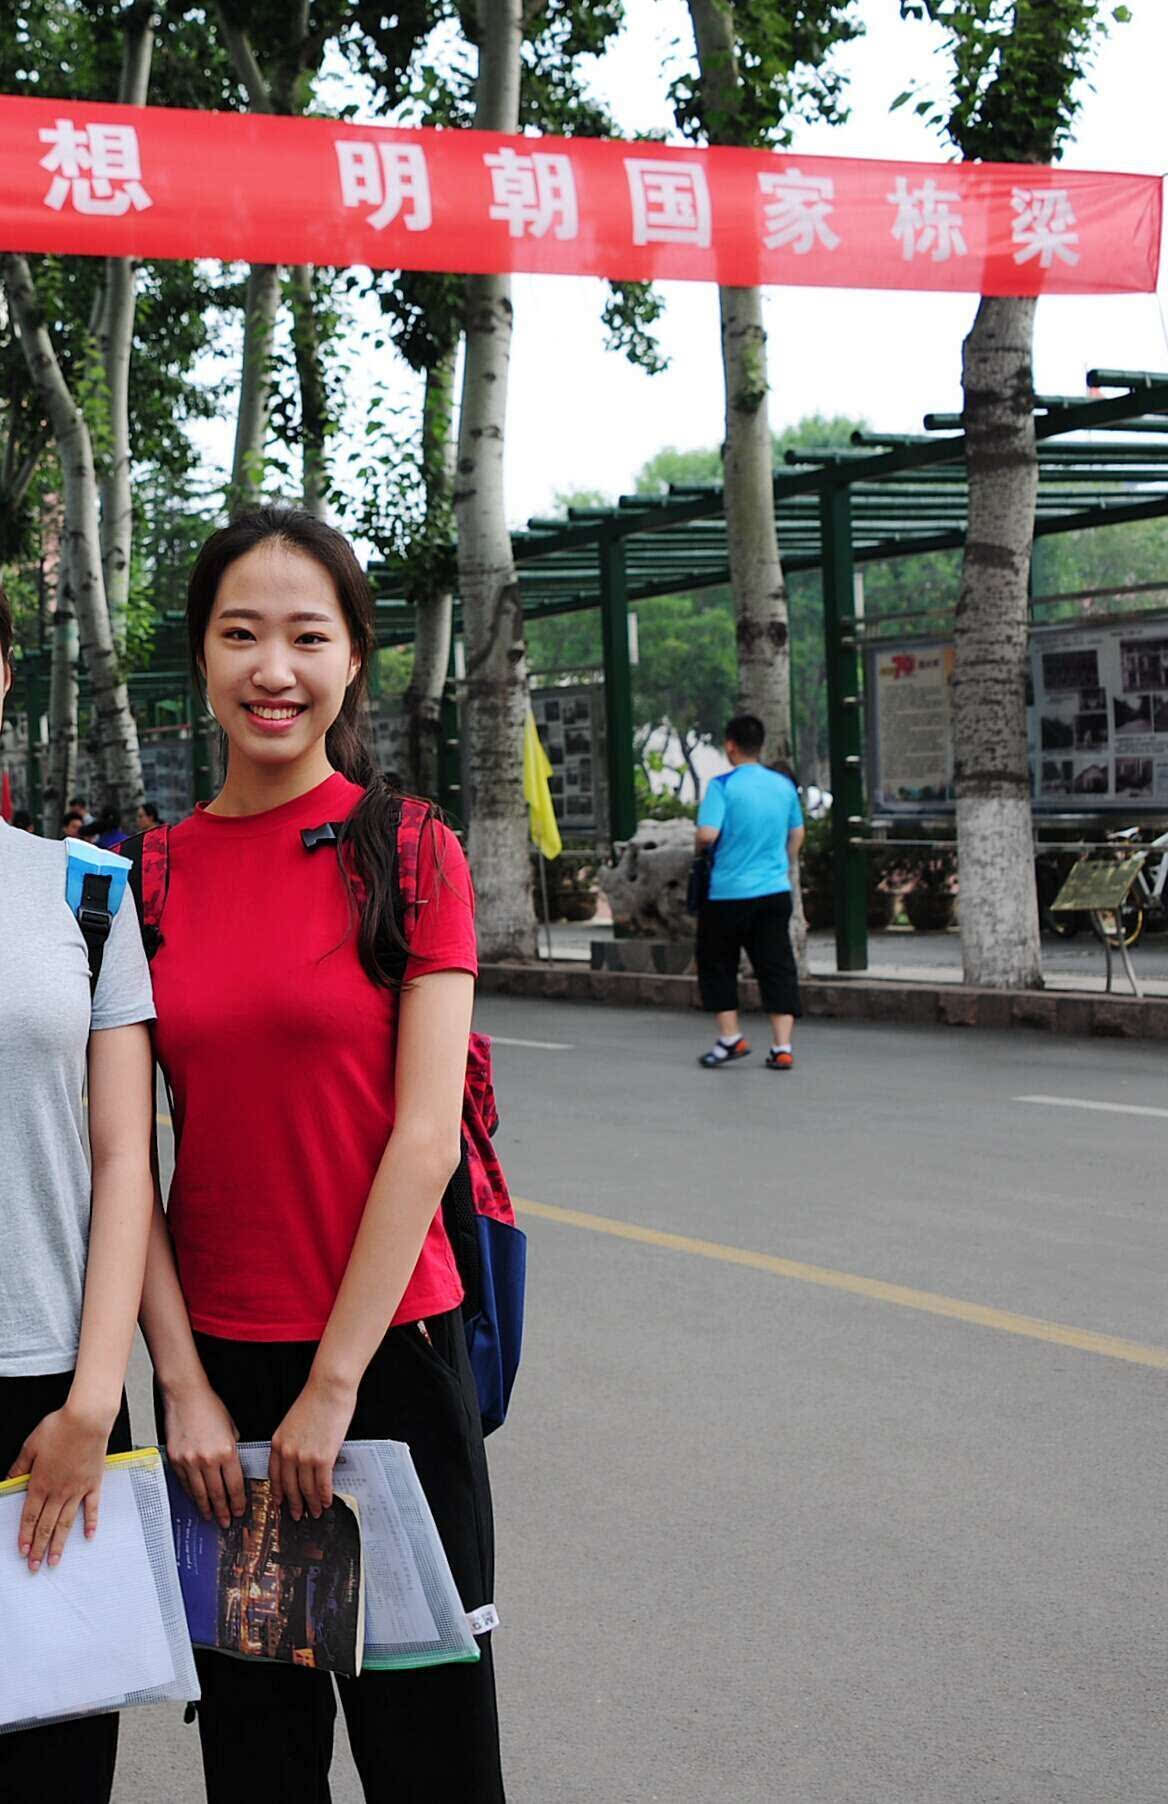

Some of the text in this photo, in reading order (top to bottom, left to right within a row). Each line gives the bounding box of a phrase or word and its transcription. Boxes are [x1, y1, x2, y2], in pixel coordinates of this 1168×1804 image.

[335, 140, 1082, 269] 明朝国家栋梁
